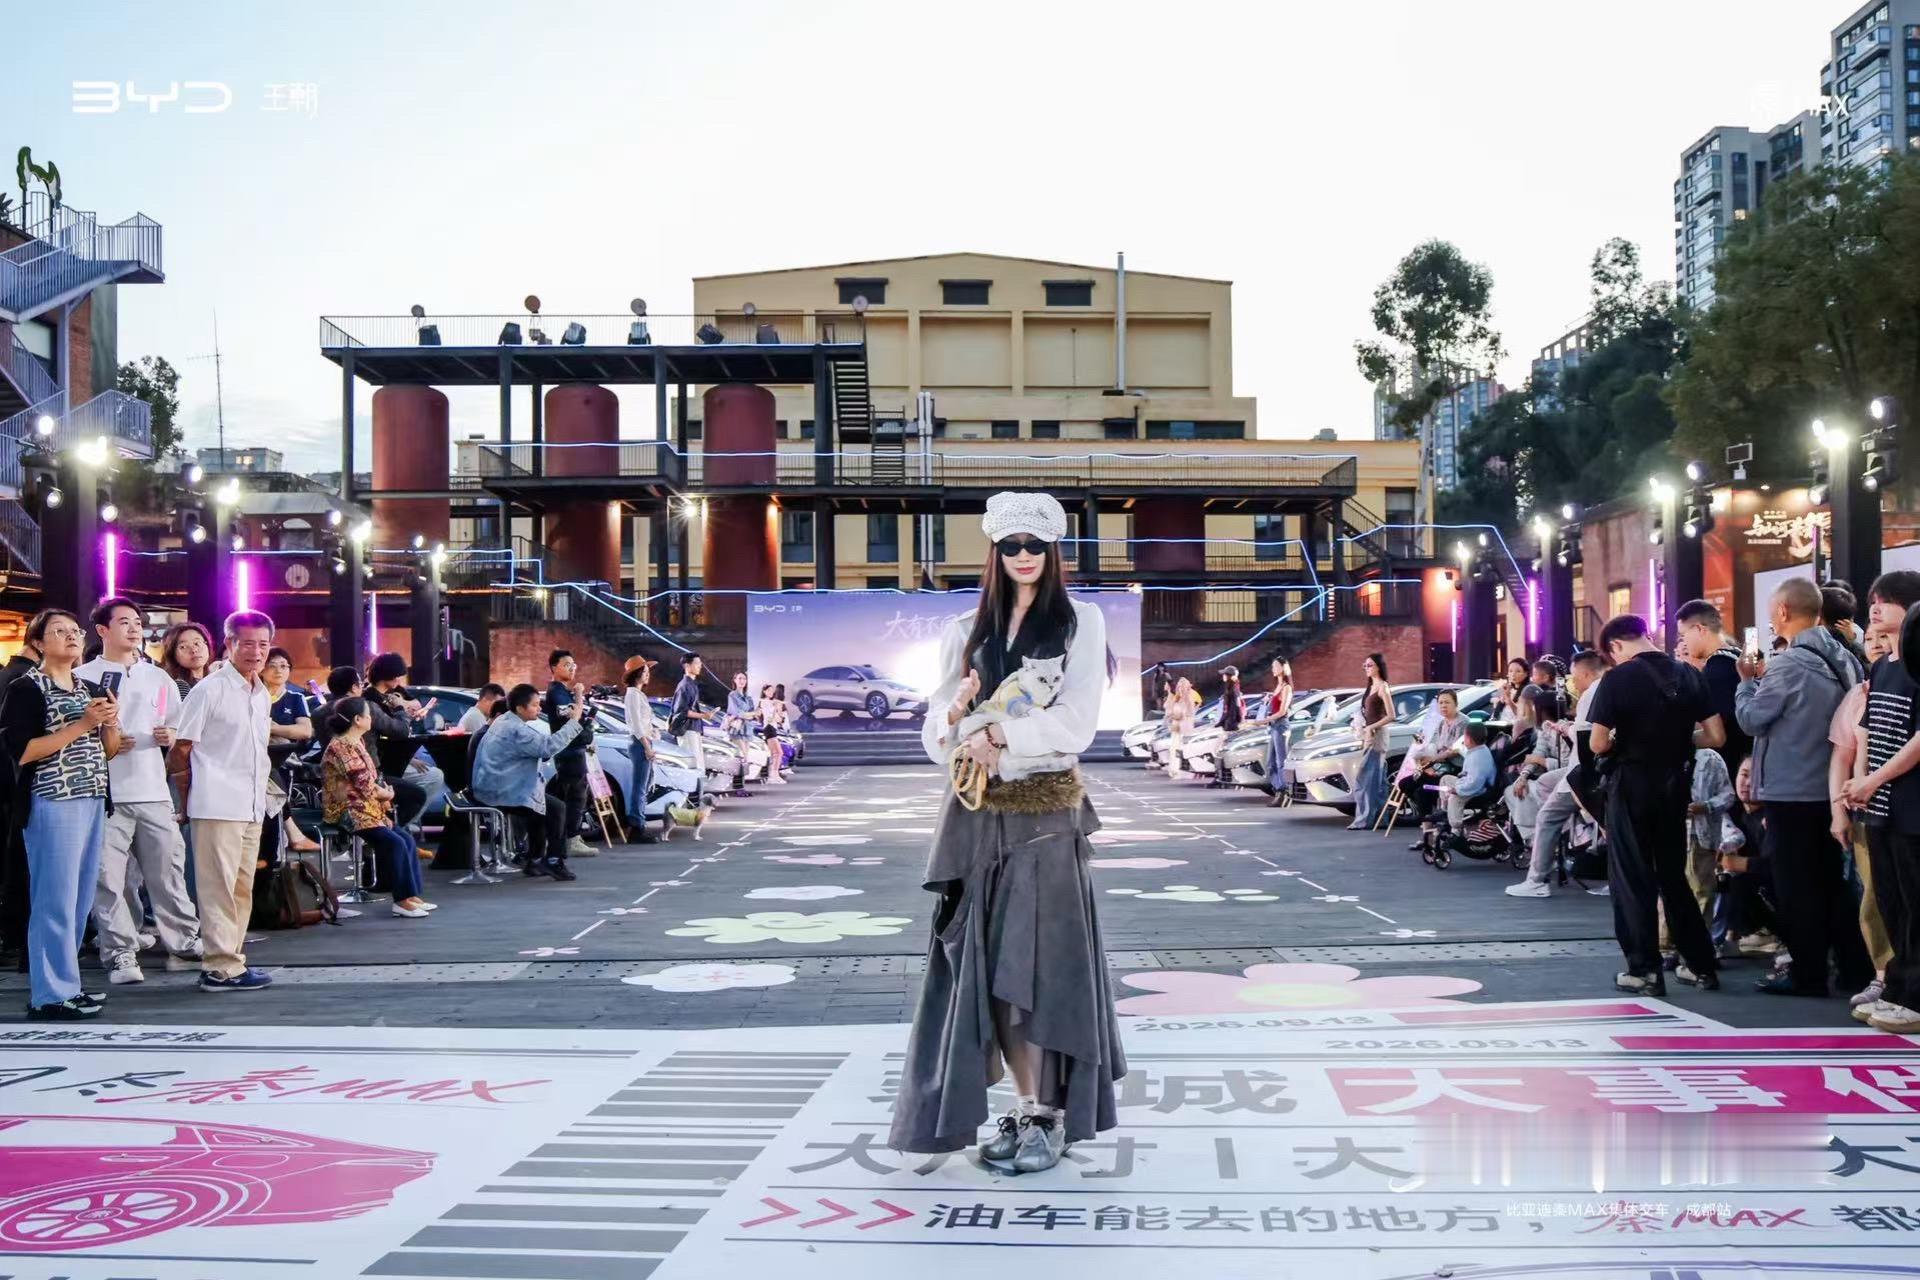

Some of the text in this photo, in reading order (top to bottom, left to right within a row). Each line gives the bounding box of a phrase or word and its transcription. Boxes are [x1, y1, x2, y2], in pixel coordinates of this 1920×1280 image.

[753, 605, 785, 613] BYD
[1134, 1016, 1374, 1032] 2026.09.13
[1323, 1039, 1590, 1050] 2026.09.13
[788, 1132, 1158, 1179] 大寸
